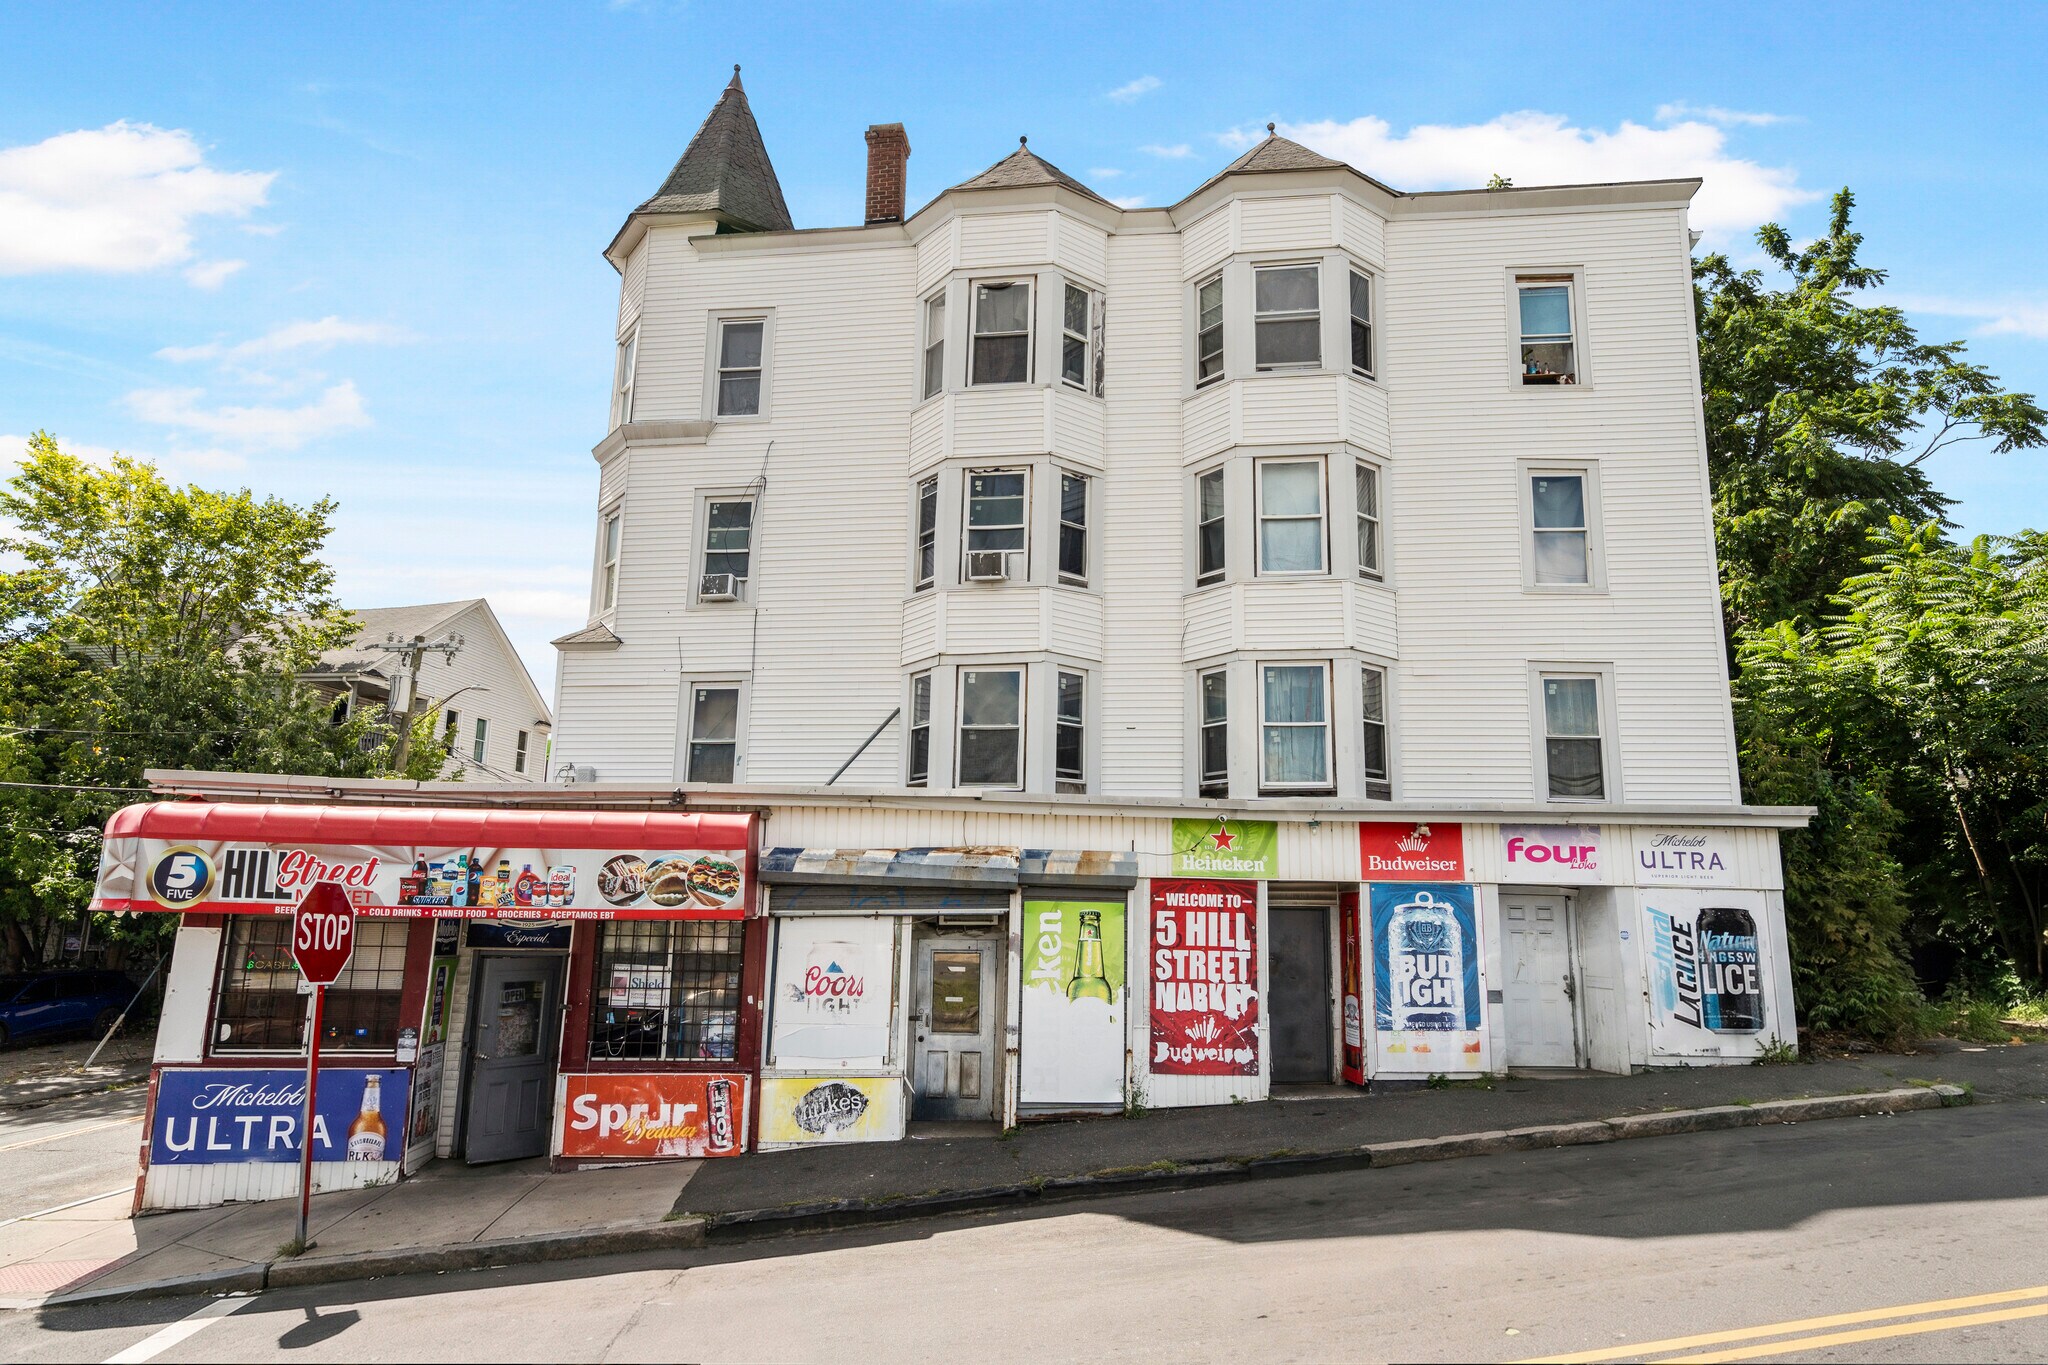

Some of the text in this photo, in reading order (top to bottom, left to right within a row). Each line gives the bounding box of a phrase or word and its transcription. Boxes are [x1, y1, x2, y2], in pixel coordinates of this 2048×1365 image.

[1507, 837, 1596, 863] four
[1651, 834, 1707, 847] Michelob
[166, 856, 197, 889] 5
[278, 851, 380, 888] Street
[1182, 855, 1265, 872] Heineken
[1368, 855, 1456, 871] Budweiser
[1570, 859, 1596, 870] Loko
[1641, 851, 1725, 870] ULTRA
[221, 850, 292, 899] HILL
[551, 872, 570, 882] ideal
[167, 889, 193, 899] FIVE
[1166, 893, 1241, 908] WELCOME TO
[275, 906, 295, 914] BEER
[369, 908, 390, 916] COLD
[392, 909, 421, 917] DRINKS
[551, 911, 598, 919] ACEPTAMOS
[600, 911, 615, 919] EBT
[298, 912, 351, 950] STOP
[504, 930, 549, 945] Especial
[1156, 911, 1251, 951] 5 HILL
[1155, 949, 1251, 984] STREET
[1399, 954, 1452, 979] BUD
[631, 977, 663, 989] Sheld
[805, 965, 863, 997] Coors
[1702, 964, 1759, 995] LICE
[1393, 979, 1455, 1006] IGH
[193, 1084, 306, 1109] Michelob
[165, 1114, 333, 1151] ULTRA
